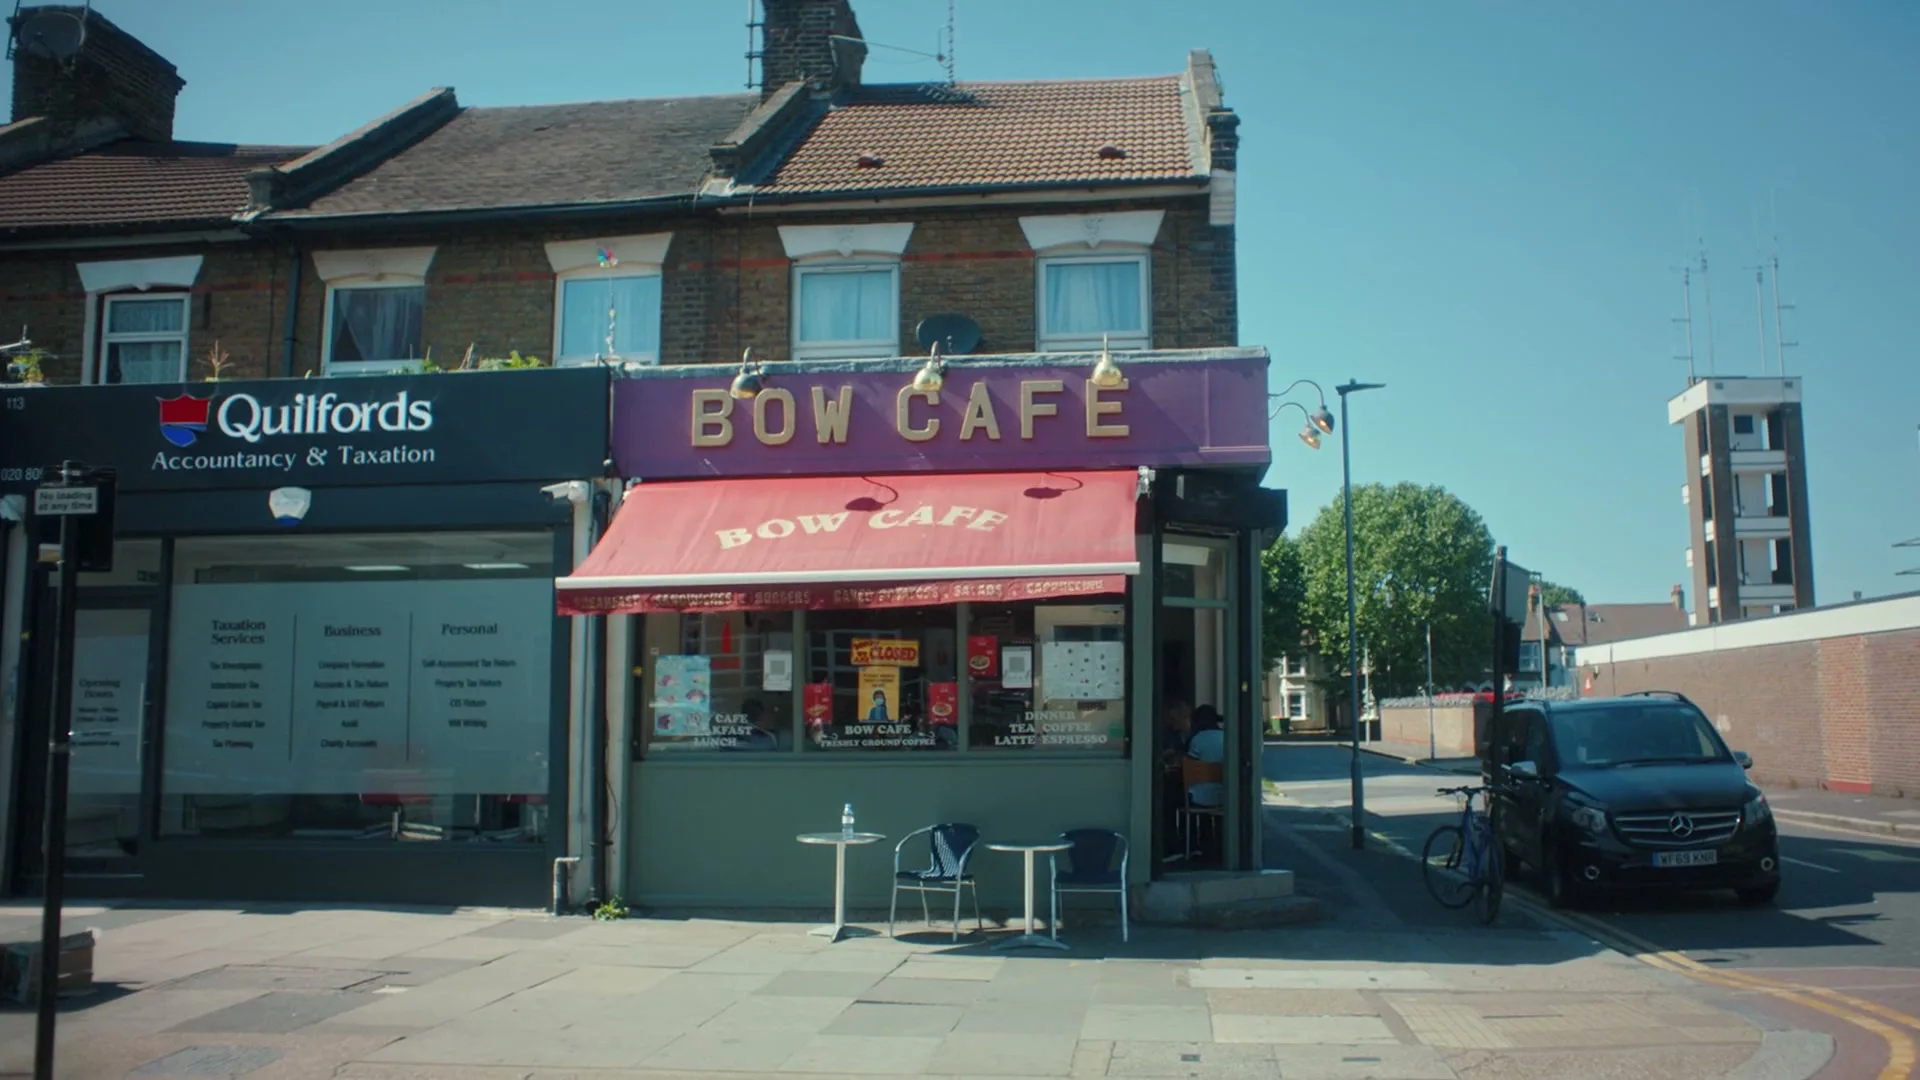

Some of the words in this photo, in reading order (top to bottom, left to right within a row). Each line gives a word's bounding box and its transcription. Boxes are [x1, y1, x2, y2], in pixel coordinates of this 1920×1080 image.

[6, 396, 25, 410] 113
[216, 390, 434, 443] Quilfords
[691, 384, 853, 447] BOW
[896, 377, 1131, 442] CAFE
[151, 450, 297, 472] Accountancy
[306, 446, 329, 467] &
[338, 444, 436, 466] Taxation
[1, 467, 23, 481] 020
[715, 511, 850, 550] BOW
[868, 504, 1009, 532] CAFE
[211, 619, 266, 631] Taxation
[324, 624, 382, 637] Business
[441, 622, 498, 636] Personal
[211, 632, 265, 645] Services
[869, 646, 917, 661] CLOSED
[715, 713, 748, 724] CAFE
[1024, 710, 1077, 721] DINNER
[844, 724, 874, 735] BOW
[876, 724, 912, 735] CAFE
[1008, 722, 1035, 733] TEA
[1042, 721, 1092, 733] COFFEE
[693, 737, 737, 747] LUNCH
[861, 738, 901, 747] GROUND
[902, 737, 937, 747] COFFEE
[993, 735, 1036, 746] LATTE
[1042, 734, 1108, 745] ESPRESSO
